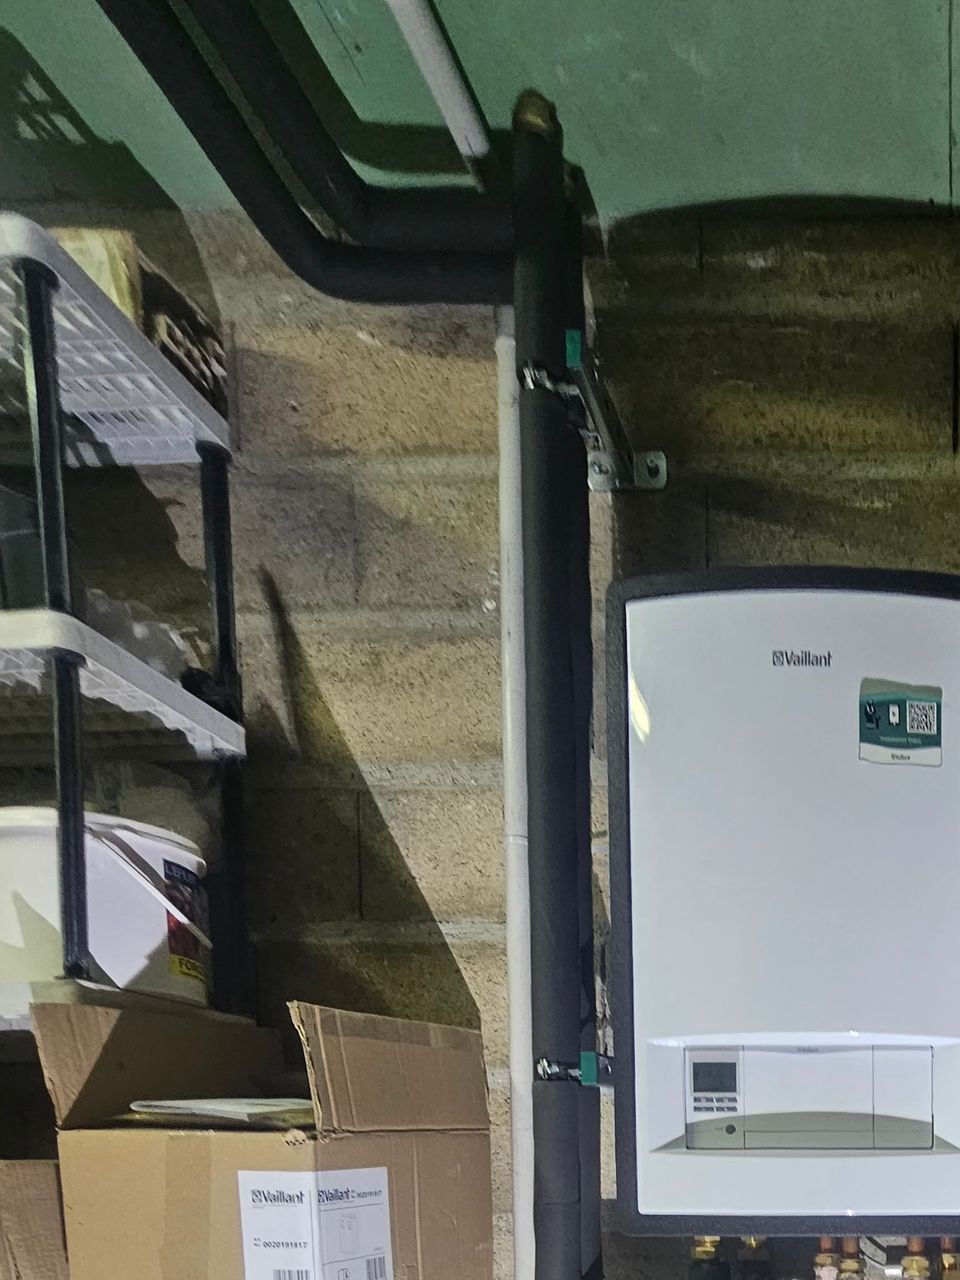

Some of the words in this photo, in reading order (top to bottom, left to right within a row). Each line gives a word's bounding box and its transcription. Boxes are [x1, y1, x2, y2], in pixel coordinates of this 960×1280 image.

[785, 650, 833, 667] Vaillant
[261, 1189, 305, 1204] Vaillant
[324, 1187, 350, 1203] Vaillant
